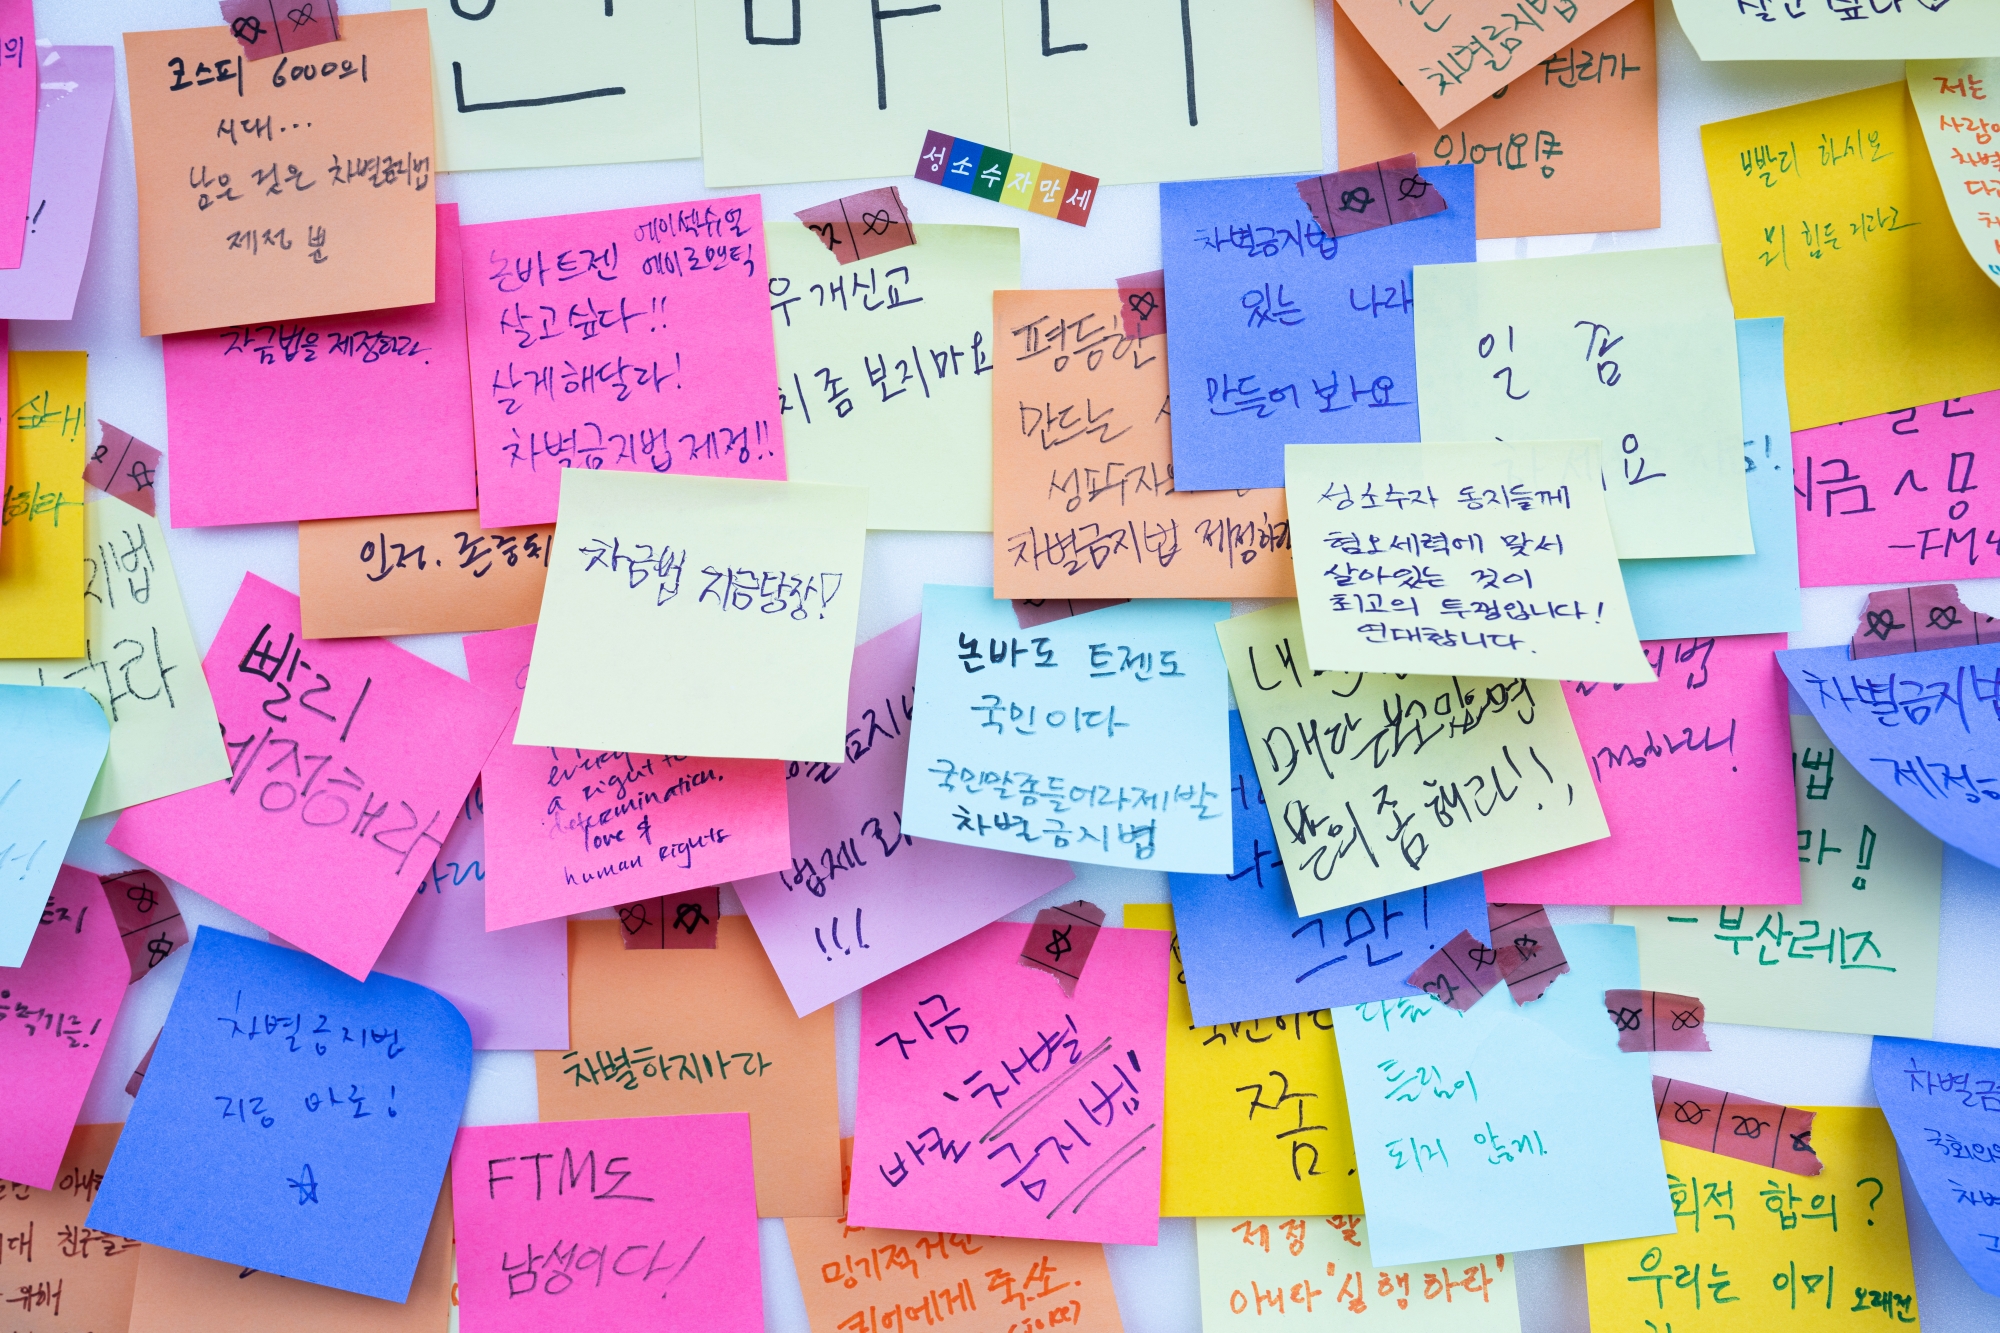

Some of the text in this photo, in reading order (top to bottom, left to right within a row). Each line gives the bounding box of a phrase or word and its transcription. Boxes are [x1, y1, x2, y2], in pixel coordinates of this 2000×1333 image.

[168, 55, 368, 96] 코스피 6000의
[1933, 74, 1987, 100] 저는
[1740, 129, 1895, 188] 빨리 하시오
[190, 166, 243, 211] 남은
[251, 163, 315, 195] 것은
[227, 229, 292, 256] 제정
[1194, 220, 1339, 259] 차별금지법
[1801, 220, 1842, 259] 힘든
[810, 266, 924, 311] 개신교
[1242, 280, 1413, 328] 있는 나라
[1012, 312, 1157, 372] 평등한
[814, 367, 854, 418] 좀
[1206, 375, 1300, 417] 만들어
[502, 421, 774, 472] 차별금지법 제정!!
[1317, 482, 1571, 511] 성소수자 동지들께
[1008, 518, 1181, 575] 차별금지법
[1322, 531, 1564, 557] 혐오세력에 맞서
[579, 537, 686, 606] 차금법
[1323, 562, 1532, 589] 살아있는 것이
[1329, 594, 1419, 616] 최고의
[958, 631, 1186, 682] 논바도 트젠도
[1357, 622, 1537, 654] 연대합니다.
[239, 622, 372, 743] 빨리
[564, 855, 643, 886] human
[218, 989, 404, 1059] 차별금지법
[875, 994, 969, 1060] 지금
[562, 1046, 773, 1090] 차별하지마라
[488, 1147, 655, 1202] FTM도
[1385, 1138, 1449, 1172] 되지
[1231, 1218, 1306, 1257] 제정
[1627, 1247, 1740, 1309] 우리는
[1772, 1260, 1834, 1309] 이미
